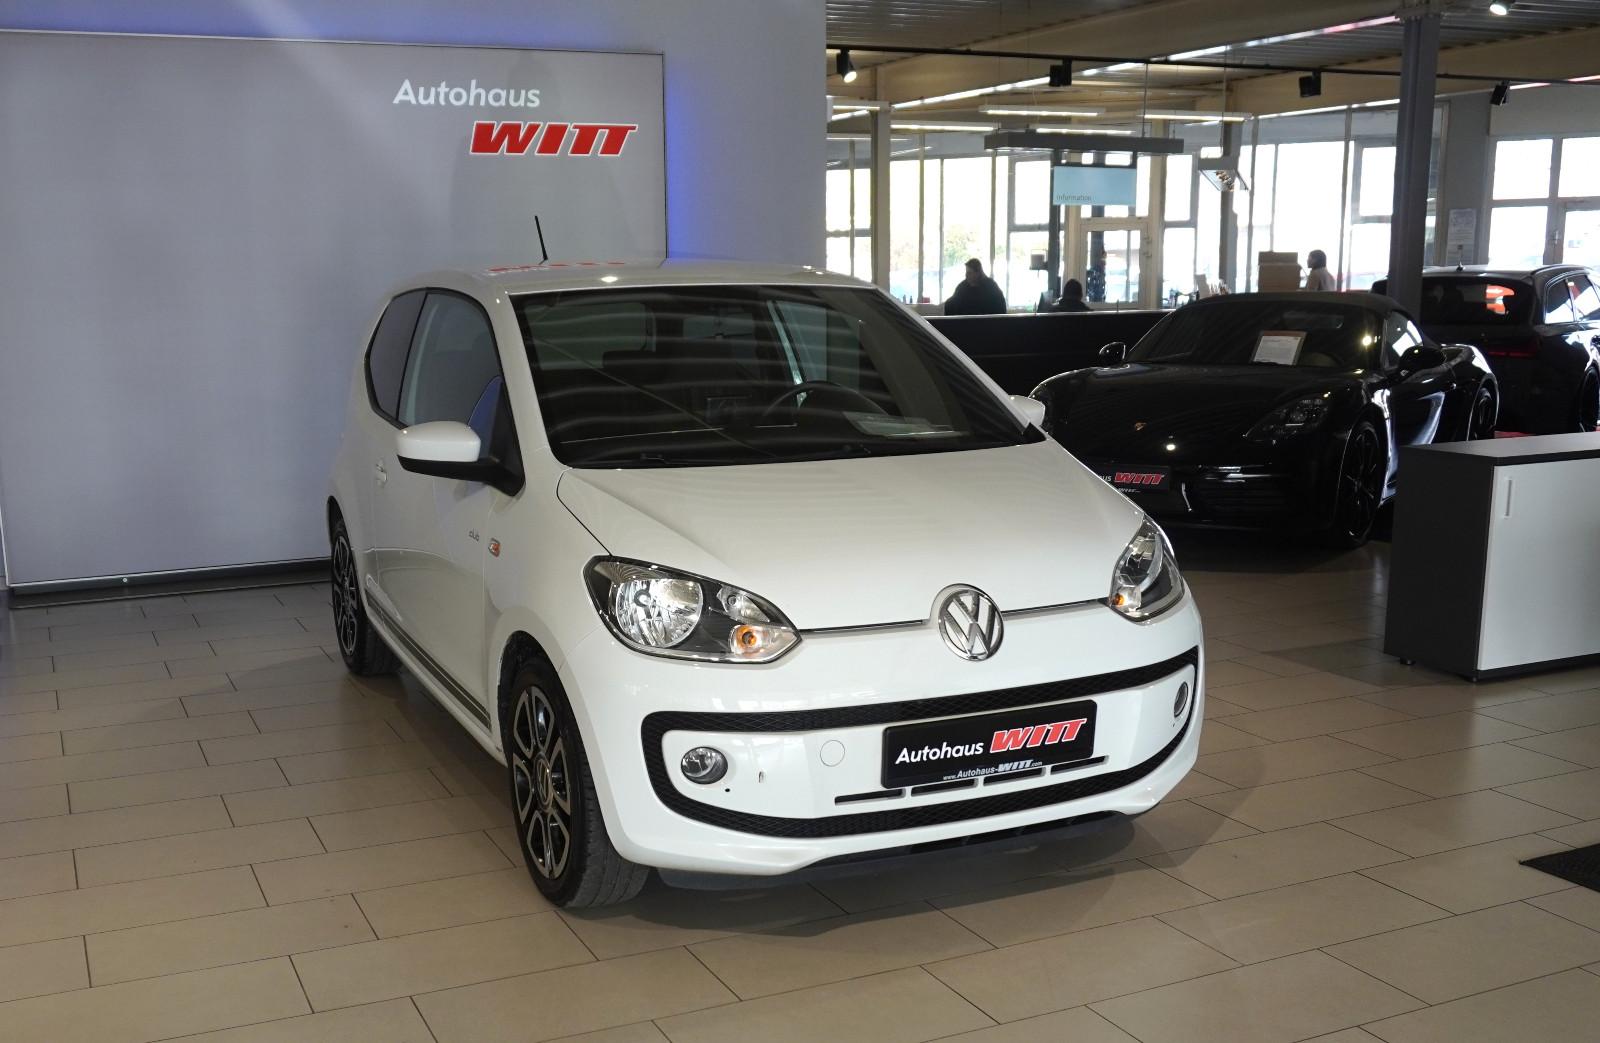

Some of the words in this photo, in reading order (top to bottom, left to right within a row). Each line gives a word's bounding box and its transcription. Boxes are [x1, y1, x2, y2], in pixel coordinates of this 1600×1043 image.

[392, 78, 541, 108] Autohaus
[469, 120, 639, 157] WITT
[1114, 472, 1165, 485] WITT
[895, 742, 984, 765] Autohaus
[989, 718, 1088, 753] WITT
